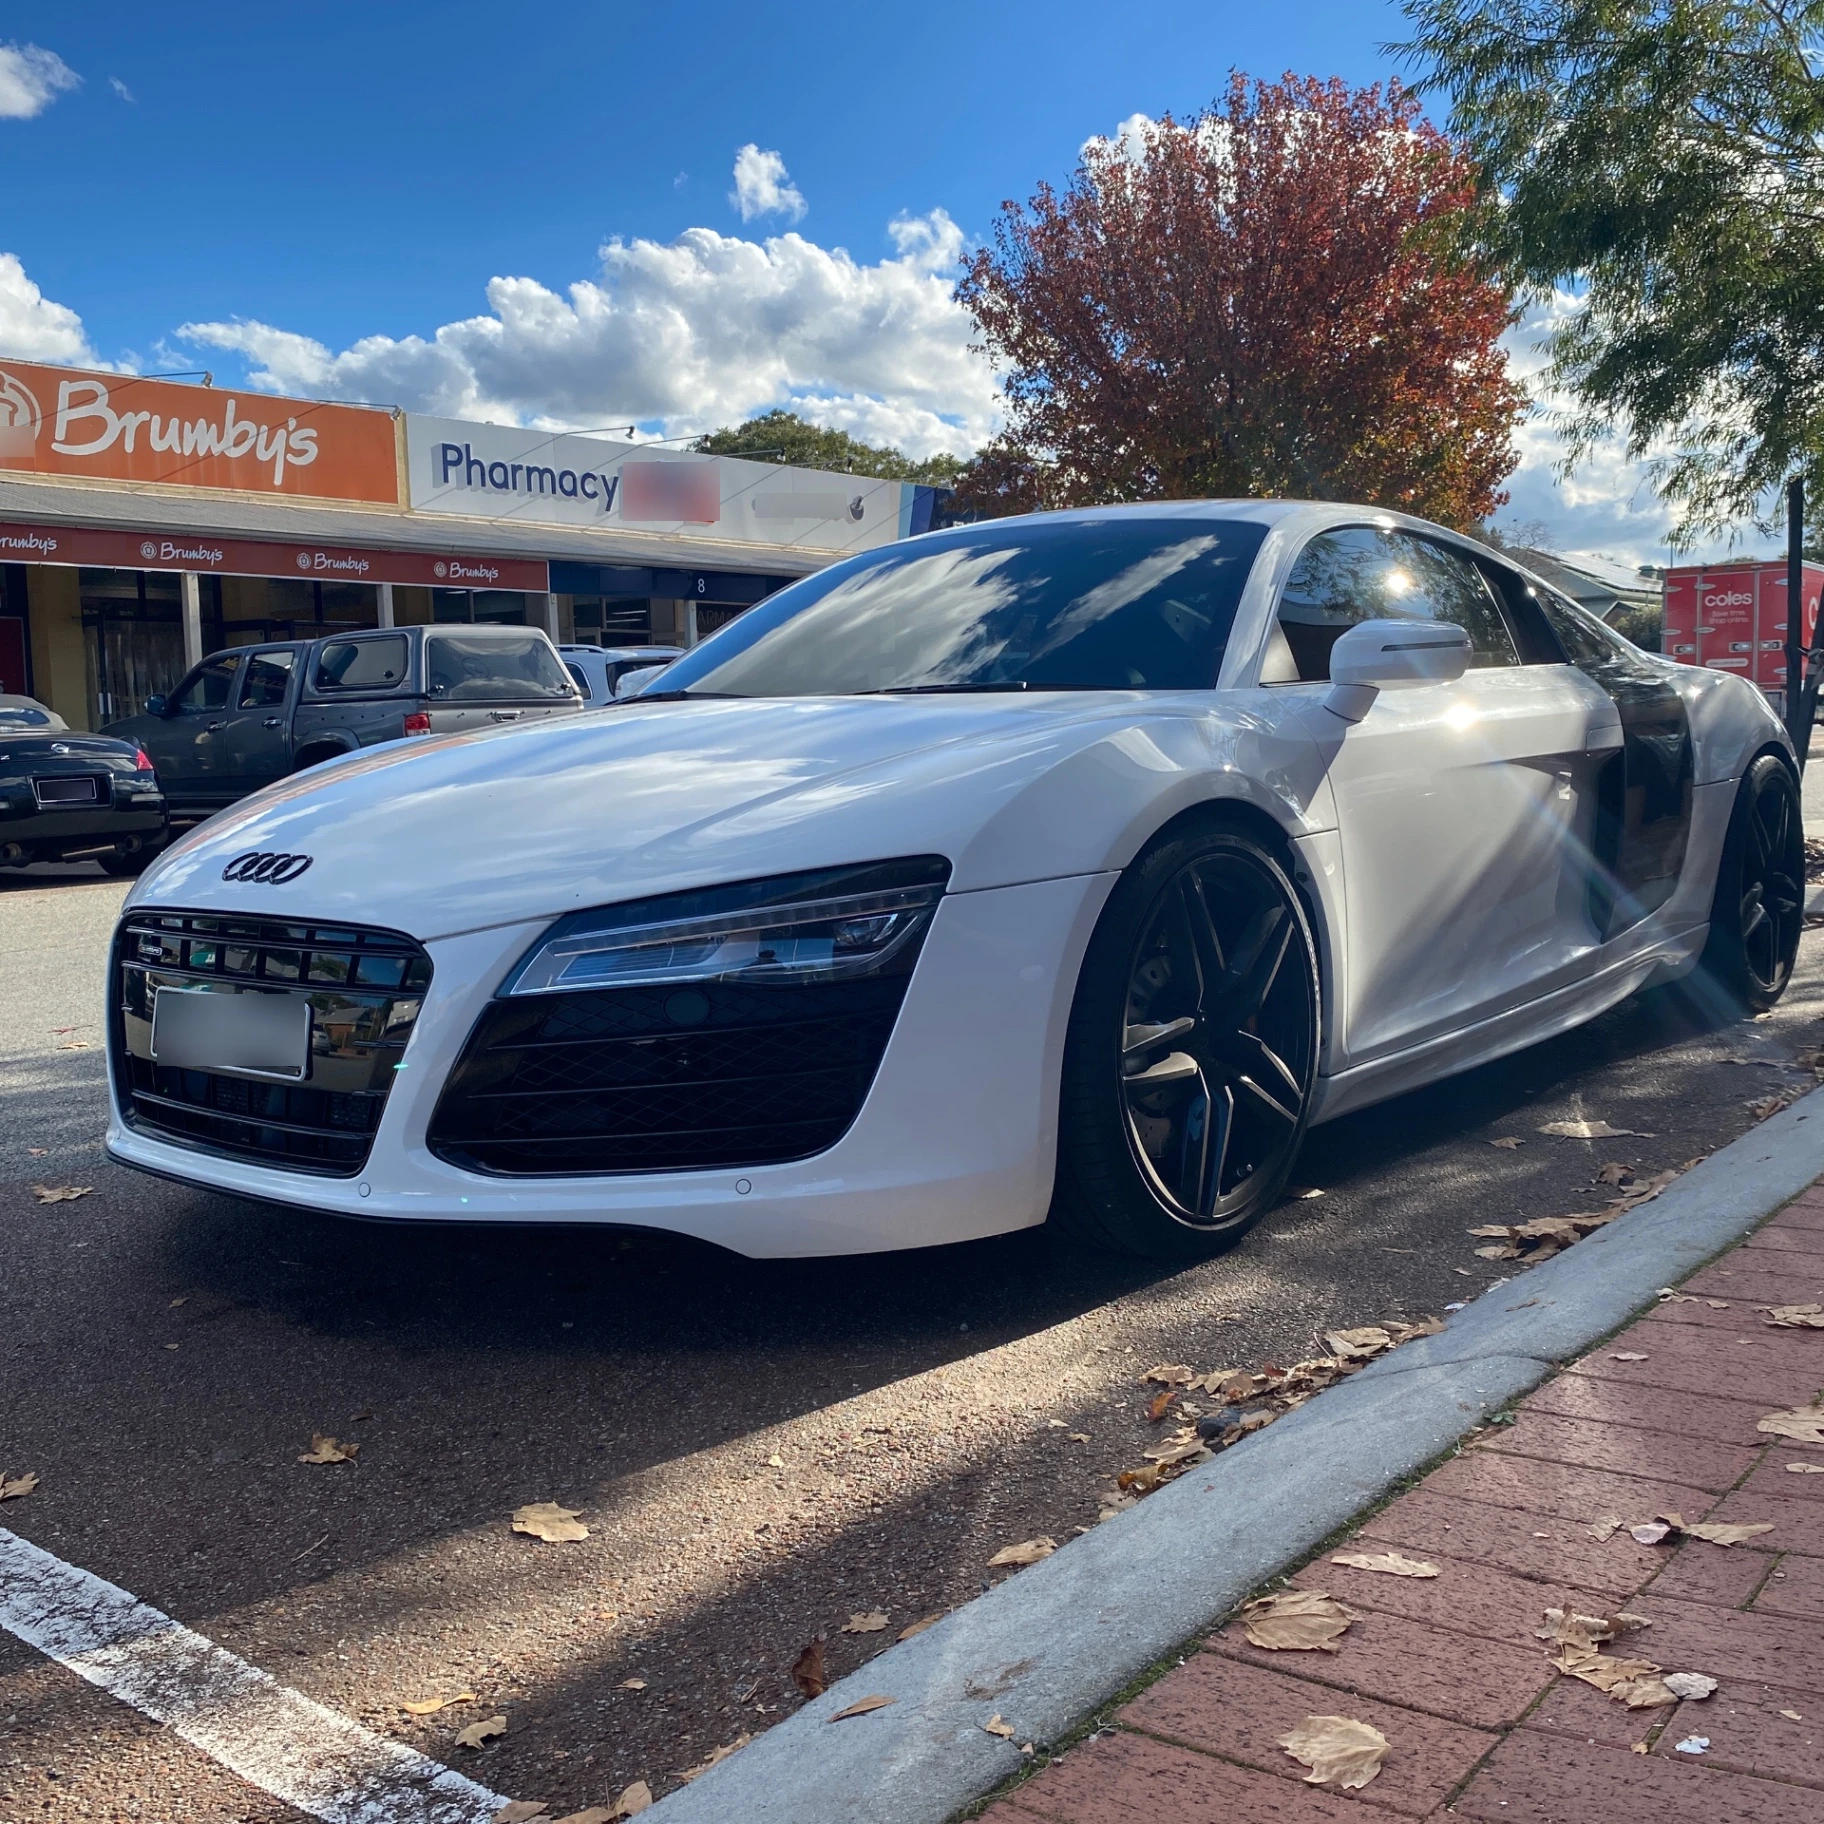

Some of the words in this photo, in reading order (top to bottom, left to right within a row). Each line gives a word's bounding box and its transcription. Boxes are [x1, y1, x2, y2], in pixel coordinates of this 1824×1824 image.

[51, 379, 319, 486] Brumby's
[441, 442, 619, 512] Pharmacy
[0, 532, 57, 556] rumby's
[159, 541, 223, 566] Brumby's
[313, 552, 370, 576] Brumby's
[449, 561, 499, 583] Brumby's
[698, 578, 705, 593] 8
[1705, 591, 1752, 607] coles
